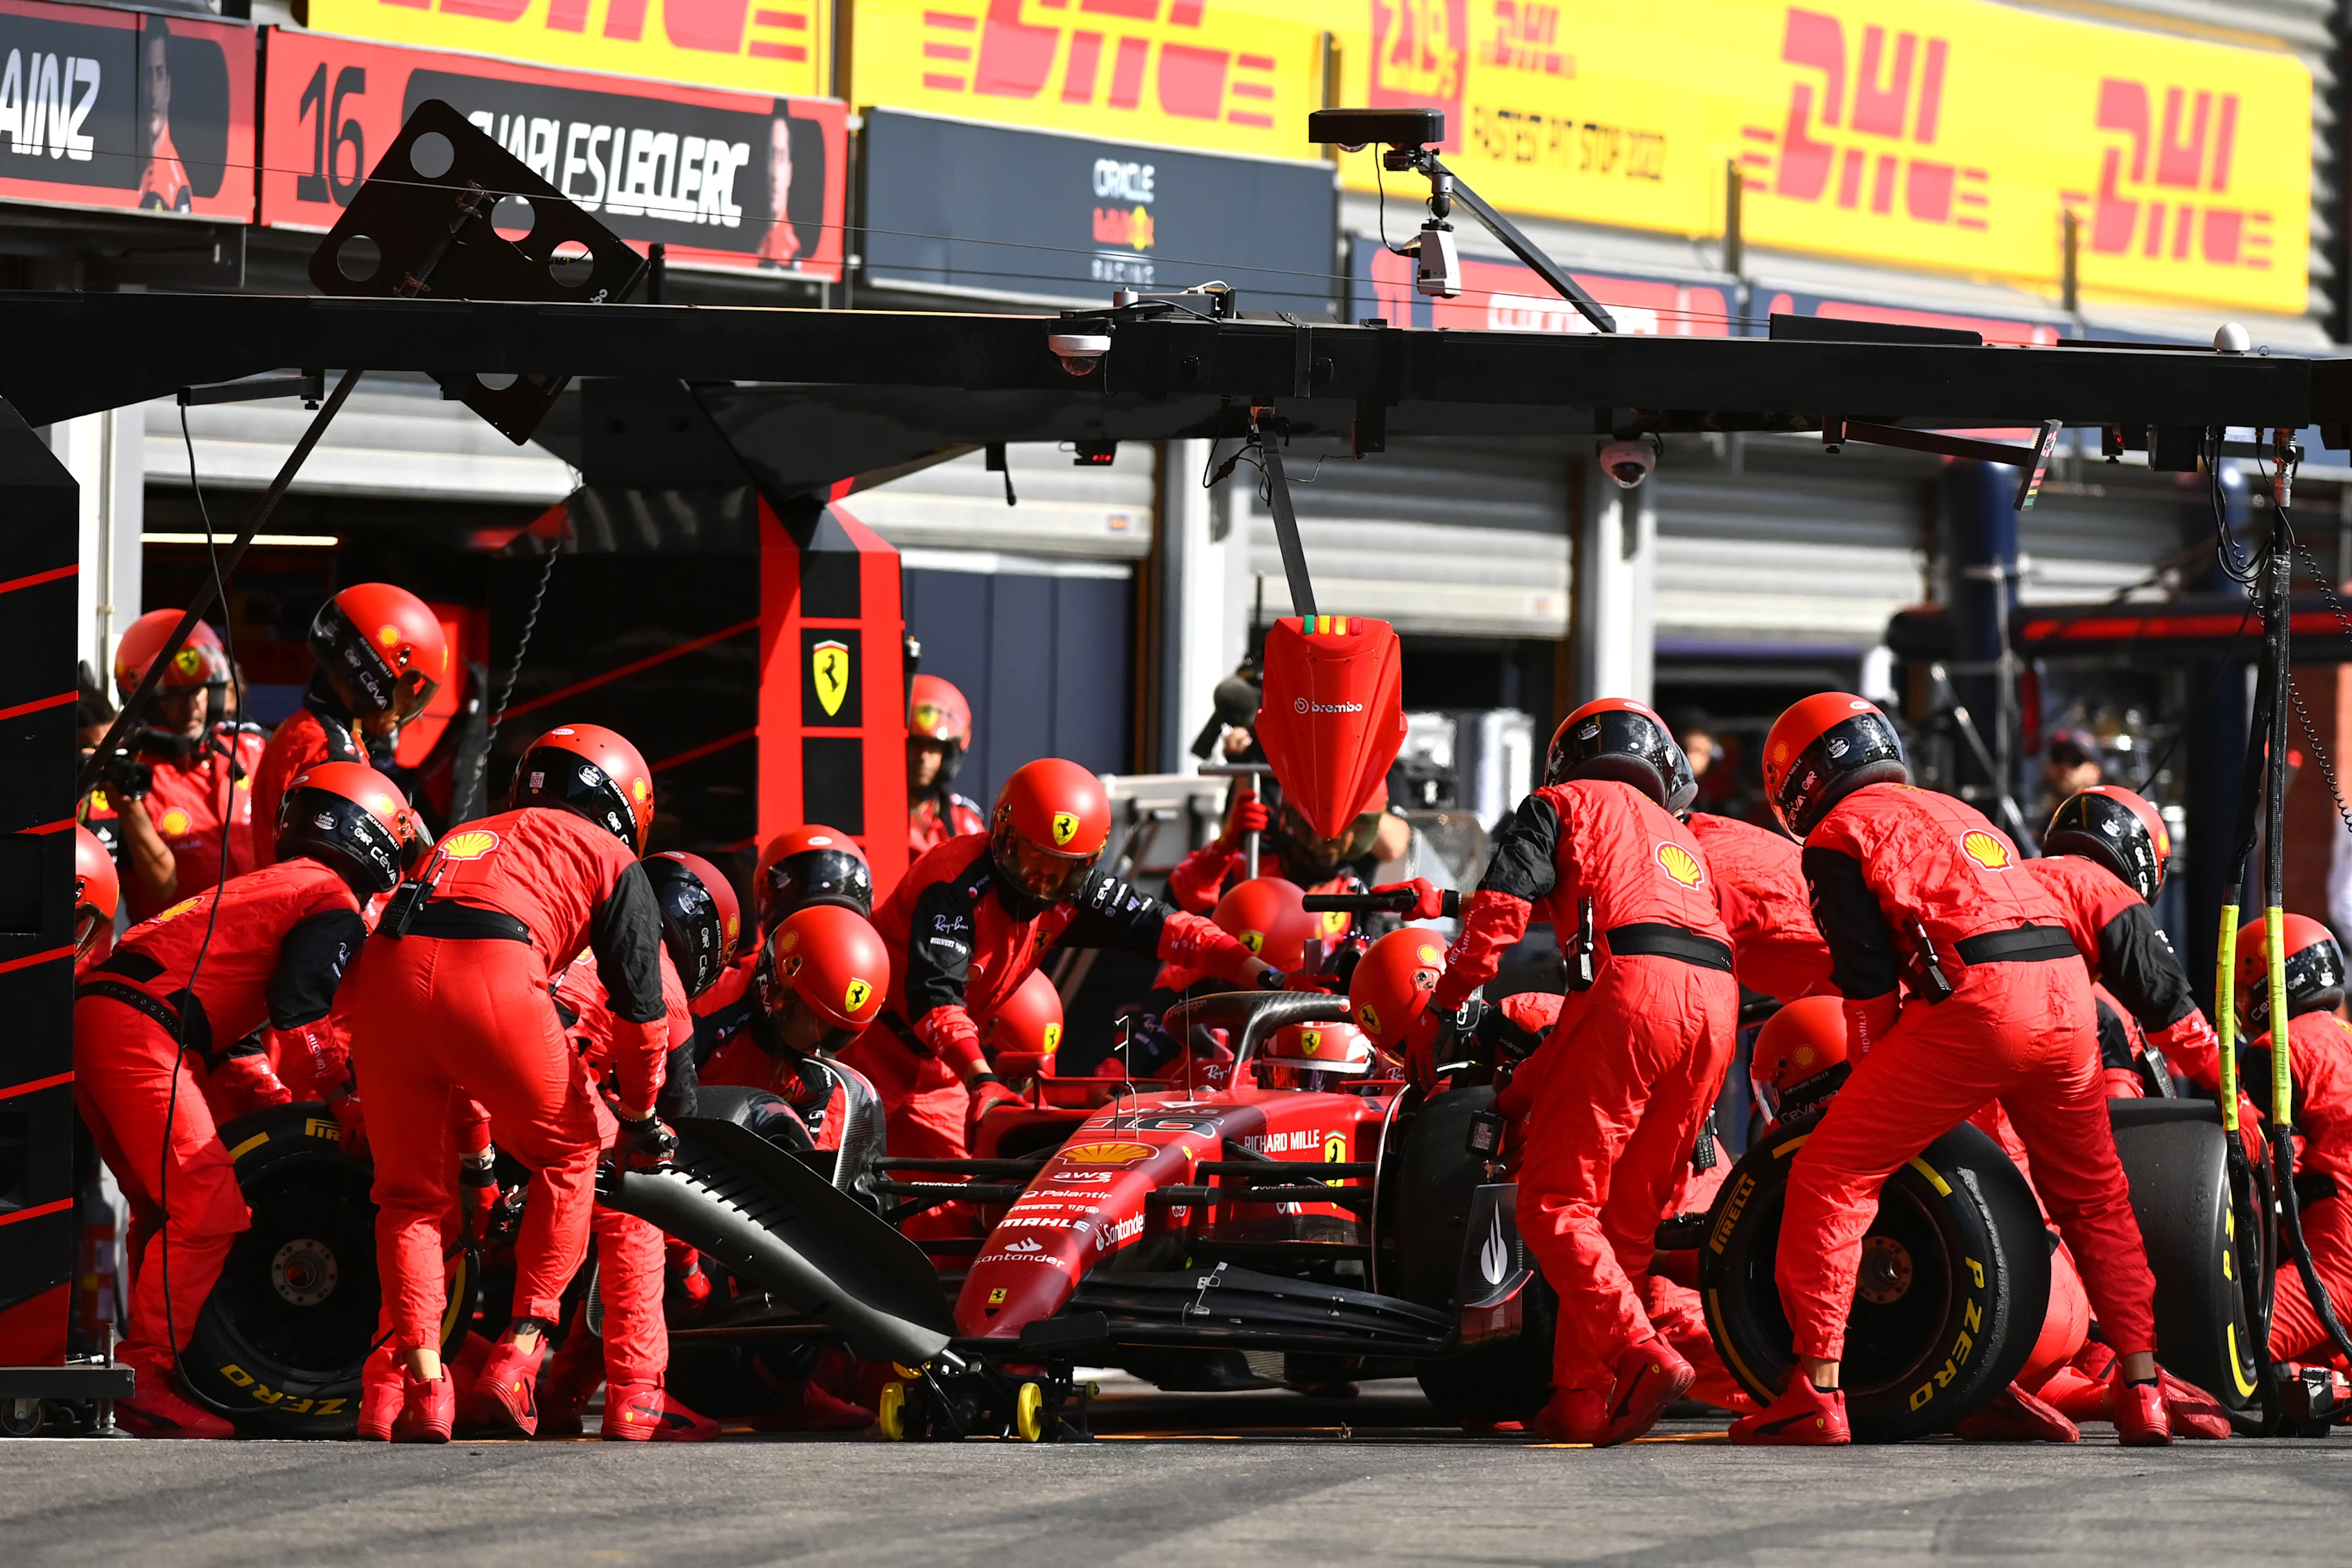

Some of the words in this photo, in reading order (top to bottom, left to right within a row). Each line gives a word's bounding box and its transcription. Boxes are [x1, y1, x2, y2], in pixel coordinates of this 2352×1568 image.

[297, 62, 366, 208] 16
[1775, 6, 1957, 225] DHL
[605, 126, 751, 229] LECLERC
[2090, 75, 2245, 266] DHL
[1311, 701, 1363, 713] brembo
[608, 779, 628, 807] RICHARD
[625, 802, 636, 825] MILLE
[365, 812, 388, 837] RICHARD
[387, 834, 401, 851] MILLE
[1244, 1132, 1288, 1153] RICHARD
[1290, 1129, 1320, 1151] MILLE
[1040, 1190, 1112, 1200] Palantir
[1053, 1171, 1114, 1180] aws
[996, 1217, 1091, 1233] MAHLE
[1709, 1172, 1756, 1255] PIRELLI
[972, 1253, 1066, 1268] Santander
[1965, 1256, 1985, 1289] P
[1909, 1297, 1983, 1412] ZERO
[219, 1364, 347, 1415] ZERO
